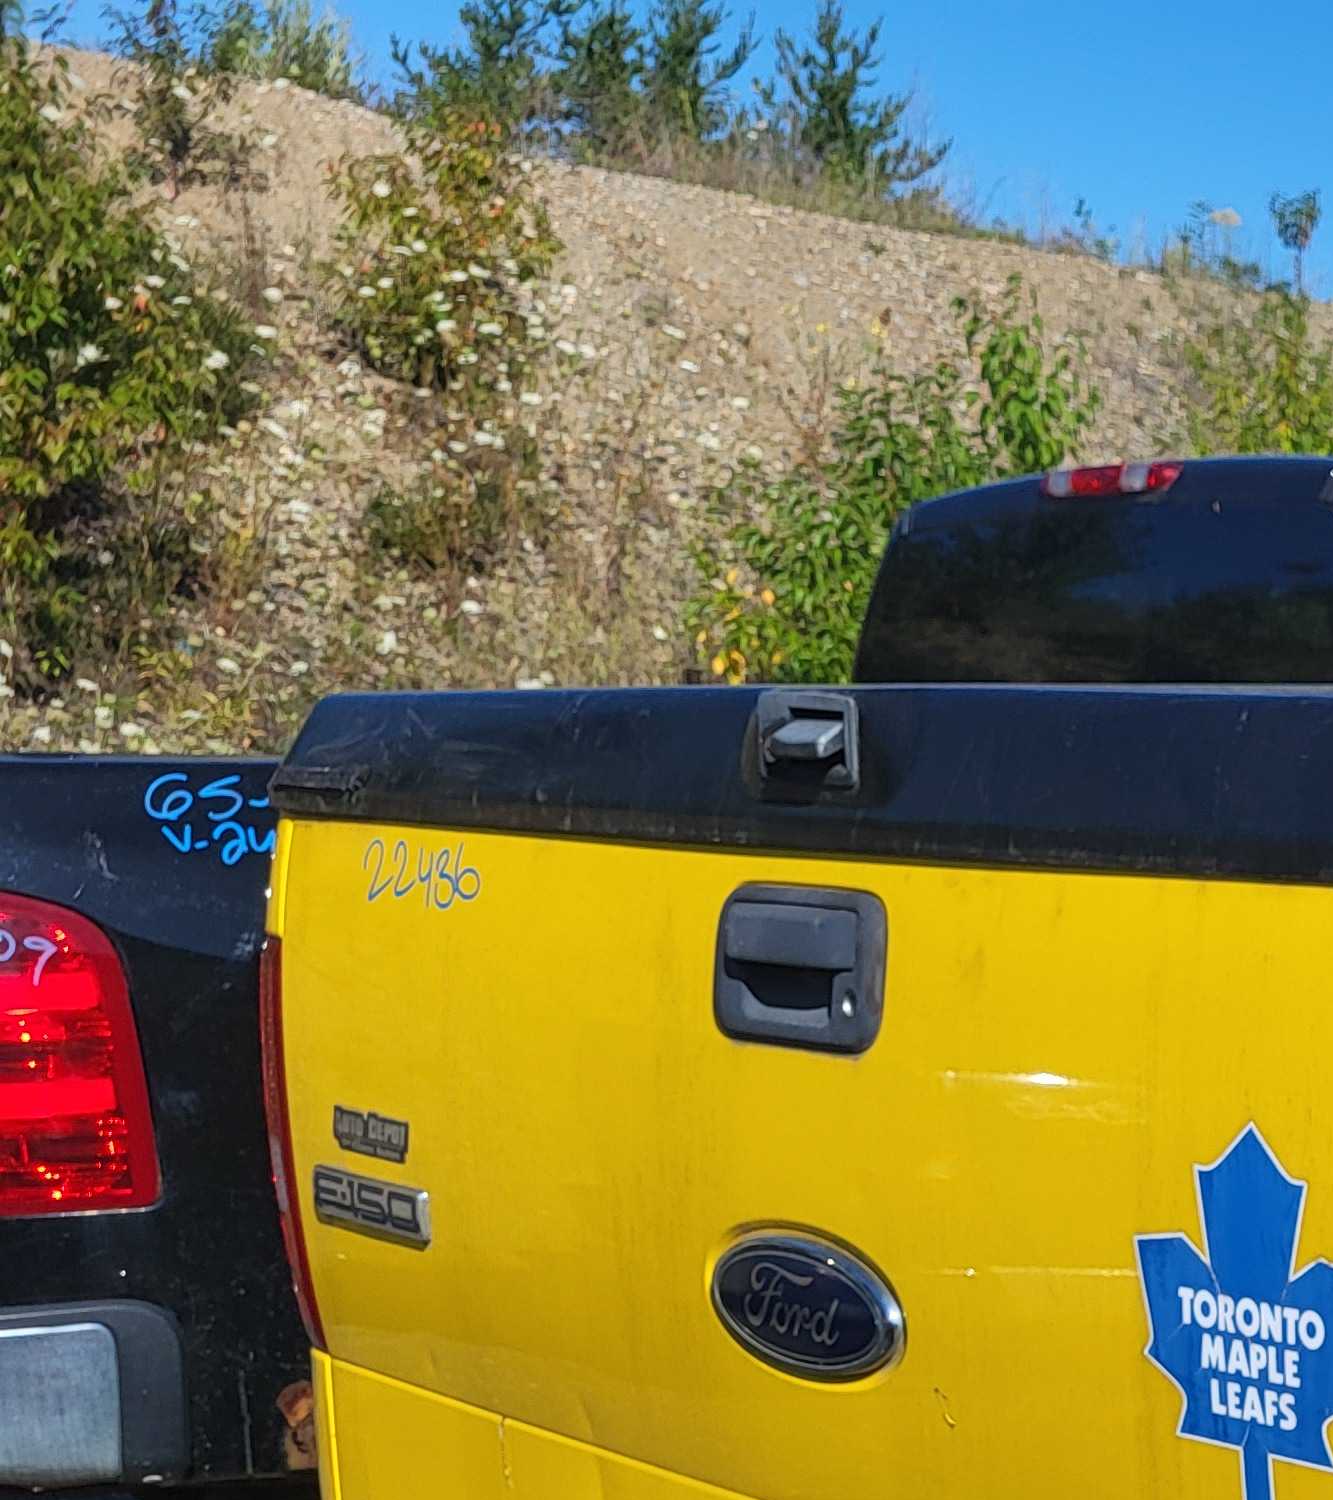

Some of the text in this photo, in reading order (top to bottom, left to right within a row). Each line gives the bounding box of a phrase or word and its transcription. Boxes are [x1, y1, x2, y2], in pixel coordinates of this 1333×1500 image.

[744, 1261, 840, 1346] Ford
[1177, 1285, 1325, 1351] TORONTO
[1201, 1332, 1301, 1389] MAPLE
[1210, 1377, 1298, 1432] LEAFS
